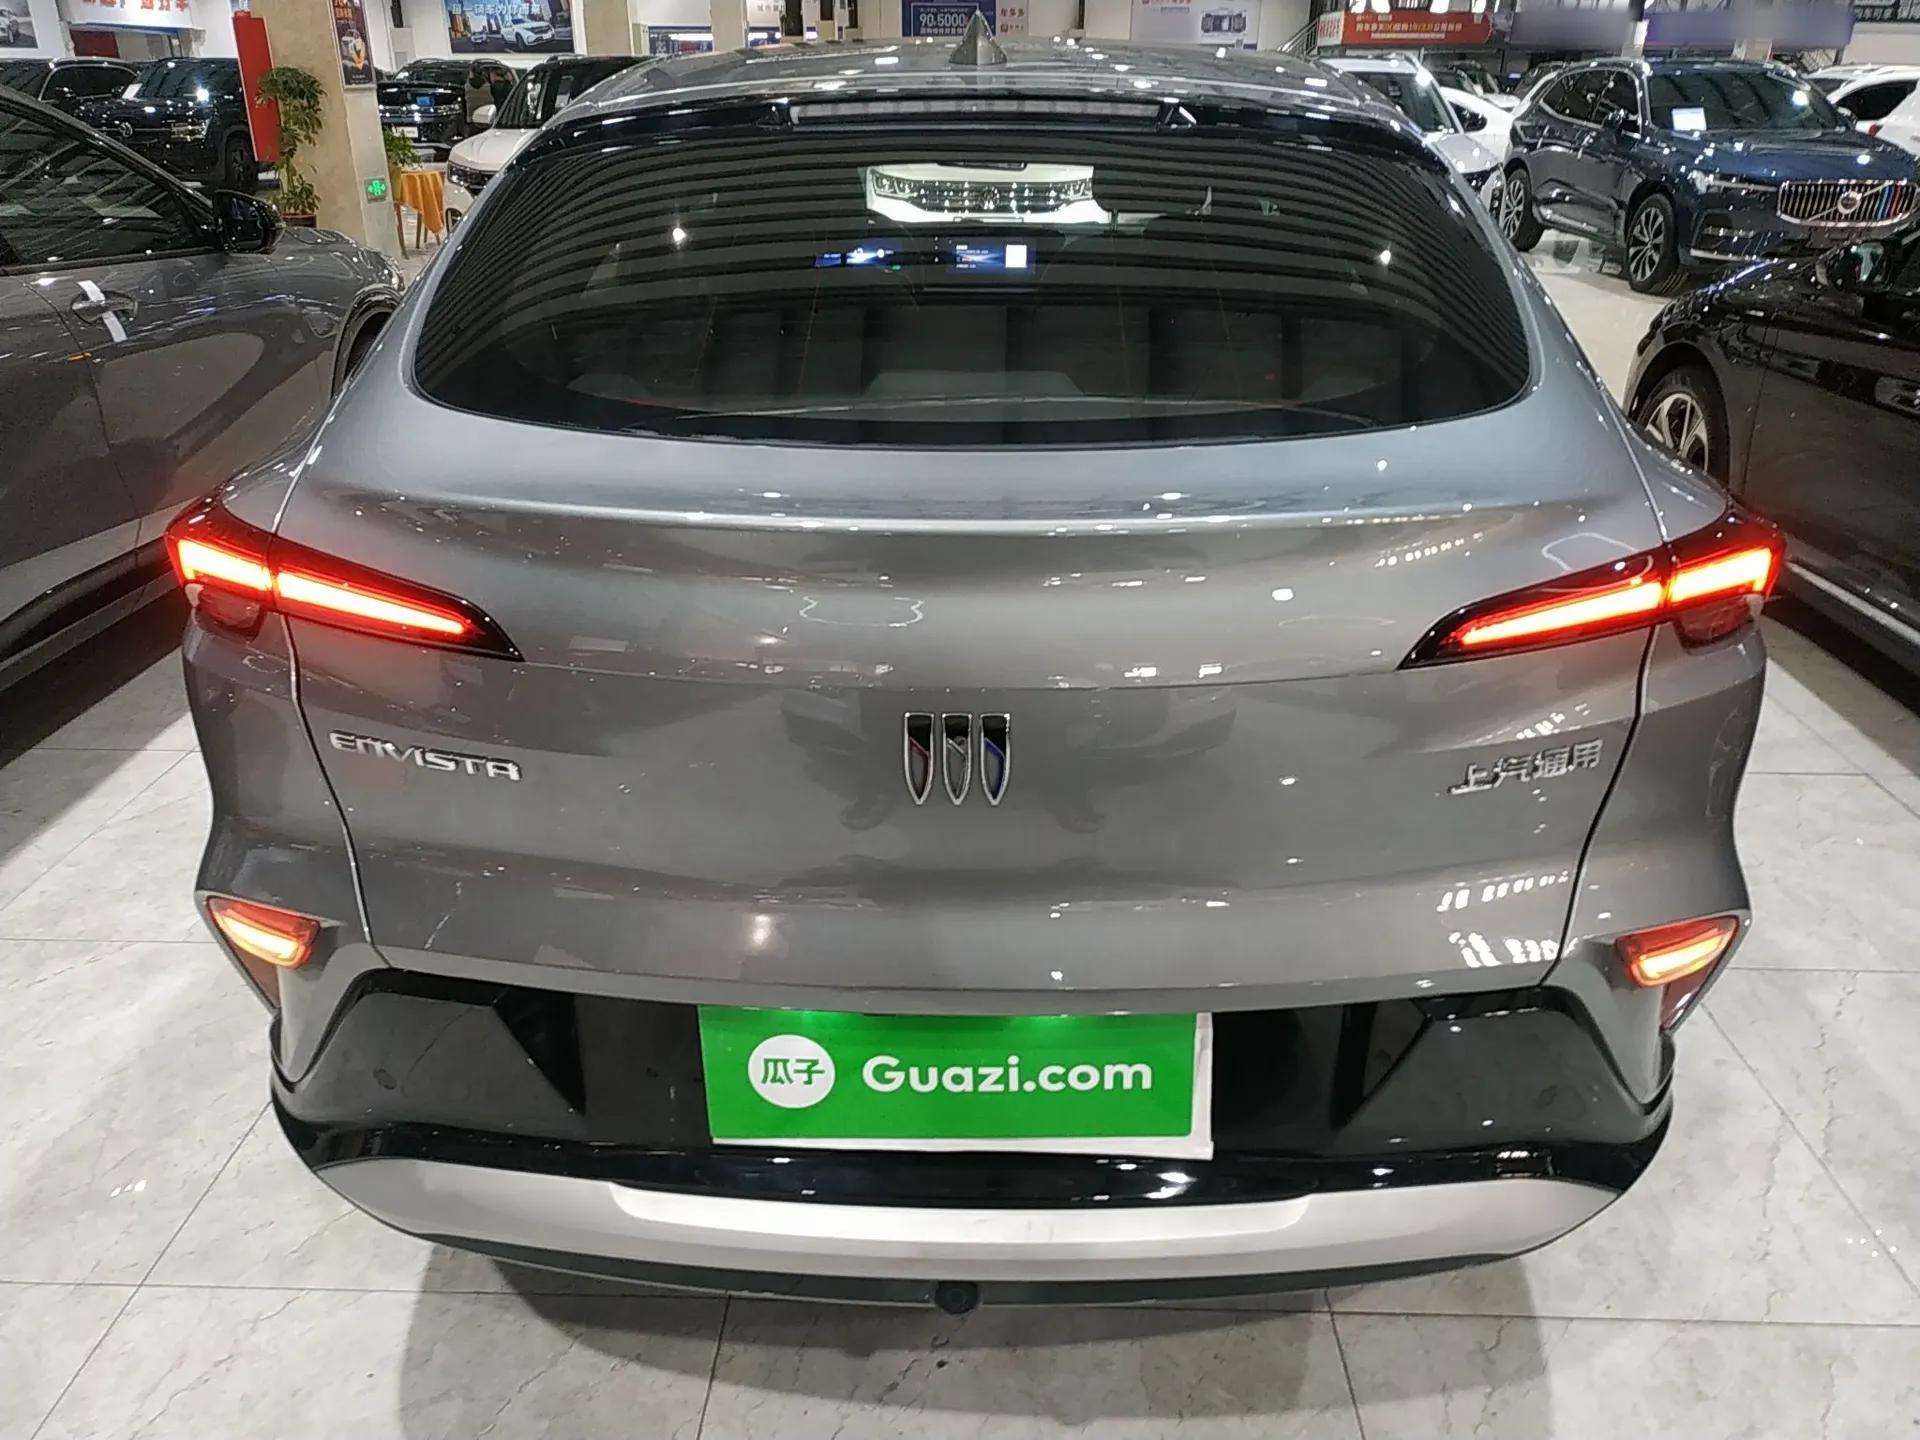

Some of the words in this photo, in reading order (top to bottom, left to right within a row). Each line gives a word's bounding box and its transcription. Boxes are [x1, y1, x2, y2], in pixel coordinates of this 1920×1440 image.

[329, 730, 522, 781] ENVISTA
[1449, 739, 1604, 795] 上汽通用
[760, 1057, 826, 1086] 瓜子
[861, 1055, 1153, 1093] Guazi.com
